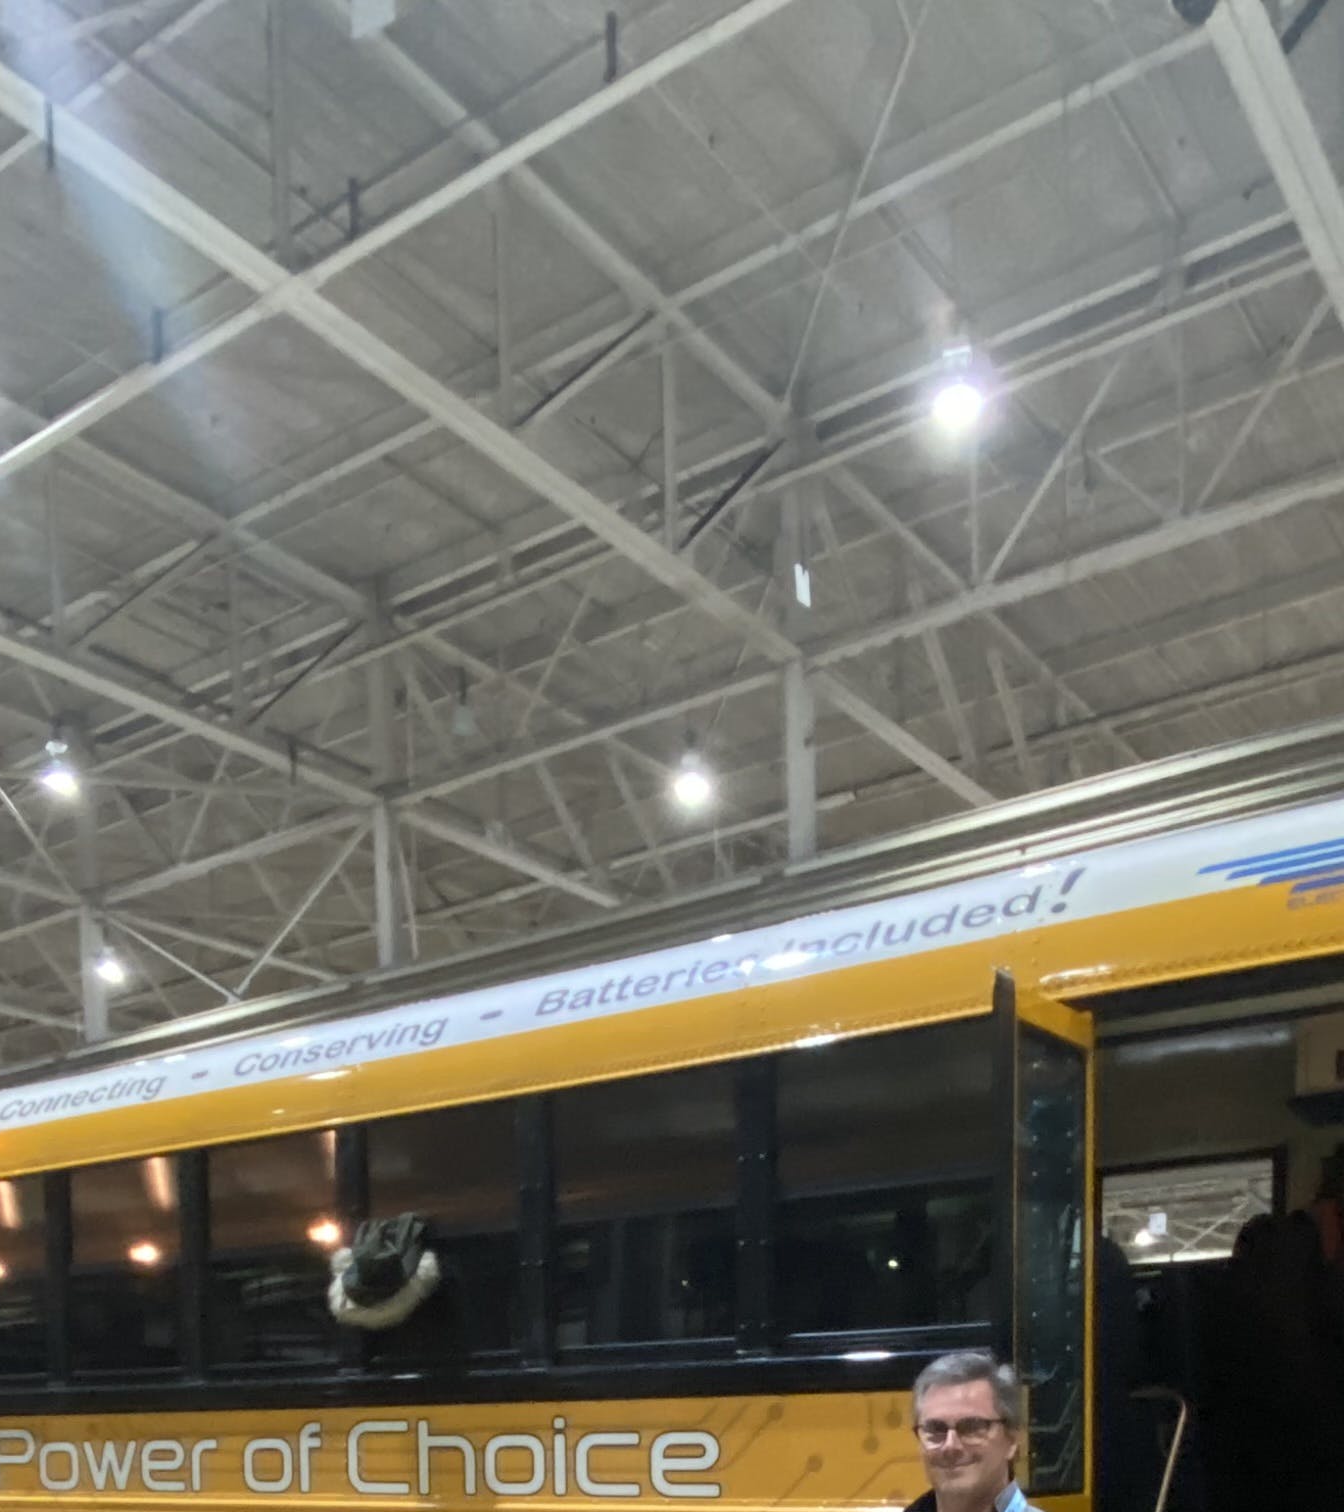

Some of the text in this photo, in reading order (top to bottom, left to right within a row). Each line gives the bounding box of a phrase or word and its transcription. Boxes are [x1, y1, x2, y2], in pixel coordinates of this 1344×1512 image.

[0, 1074, 167, 1122] Connecting
[234, 1017, 451, 1078] Conserving
[243, 1422, 322, 1493] of
[346, 1416, 722, 1497] Choice
